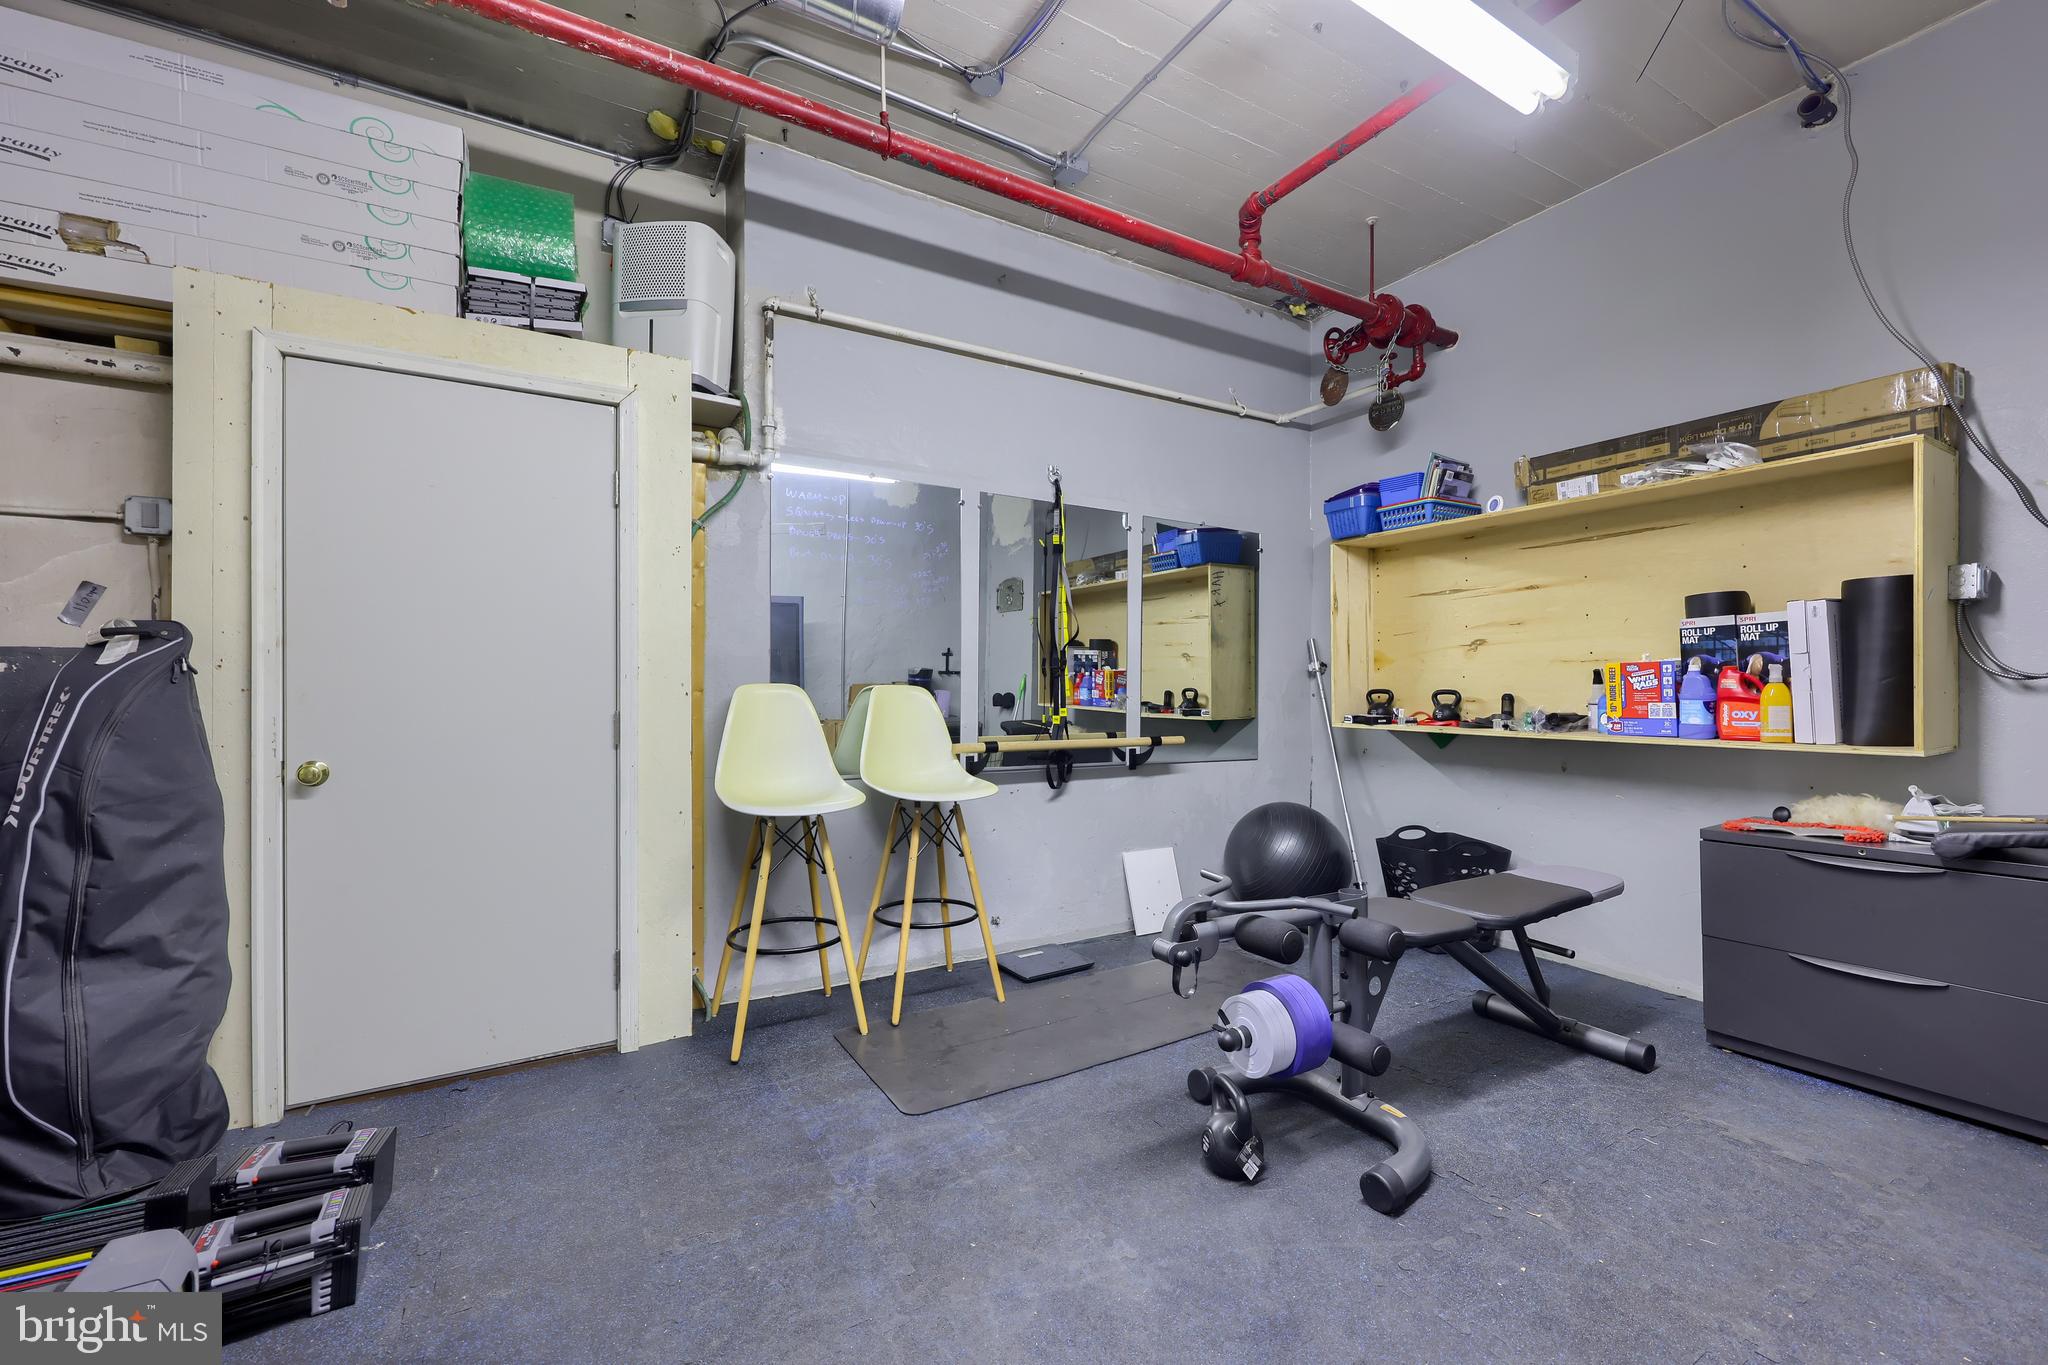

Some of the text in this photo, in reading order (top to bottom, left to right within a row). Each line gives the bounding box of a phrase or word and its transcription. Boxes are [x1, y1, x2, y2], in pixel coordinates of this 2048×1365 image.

[1681, 627, 1716, 637] ROLL UP
[1740, 622, 1779, 634] ROLL UP
[1681, 636, 1699, 645] MAT
[1740, 632, 1760, 642] MAT
[1627, 674, 1656, 685] WHITE
[1632, 678, 1660, 690] RAGS
[1609, 684, 1617, 702] MORE
